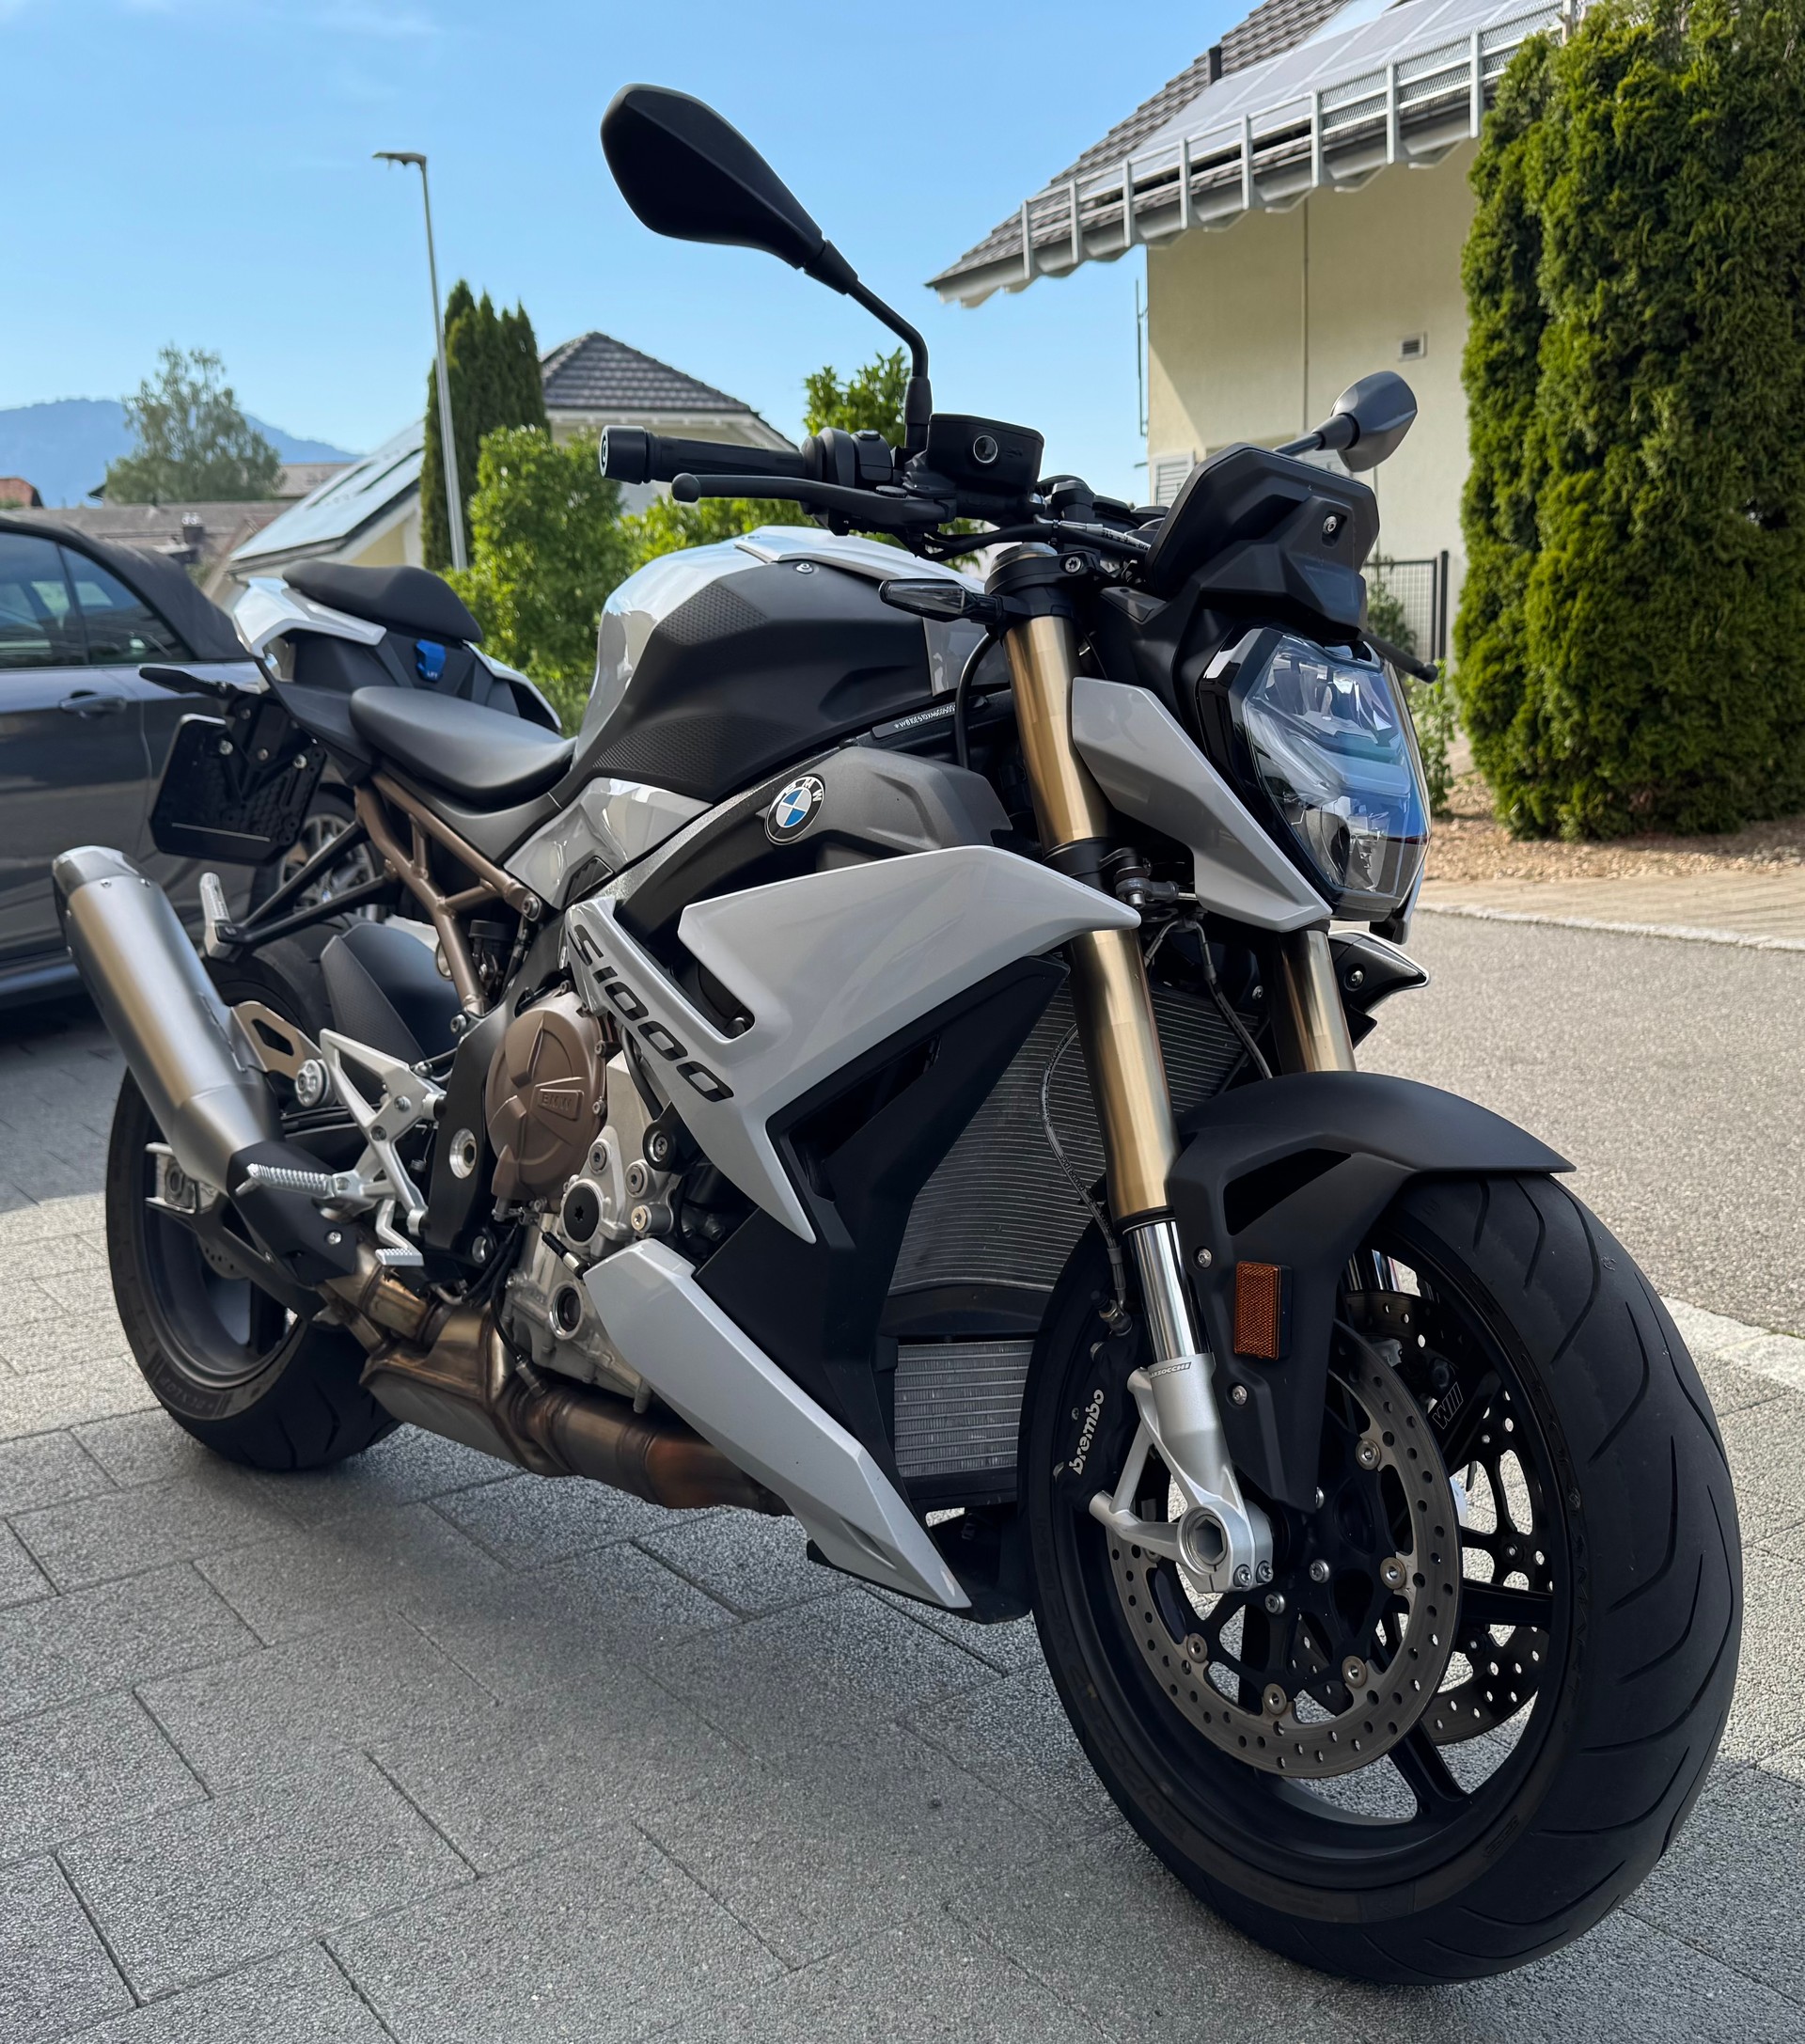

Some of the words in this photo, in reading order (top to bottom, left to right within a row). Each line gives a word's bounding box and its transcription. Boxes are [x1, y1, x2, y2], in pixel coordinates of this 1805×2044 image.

[541, 1093, 572, 1110] BMW
[1150, 1362, 1191, 1378] ARZOCCHI
[1068, 1389, 1105, 1475] brembo
